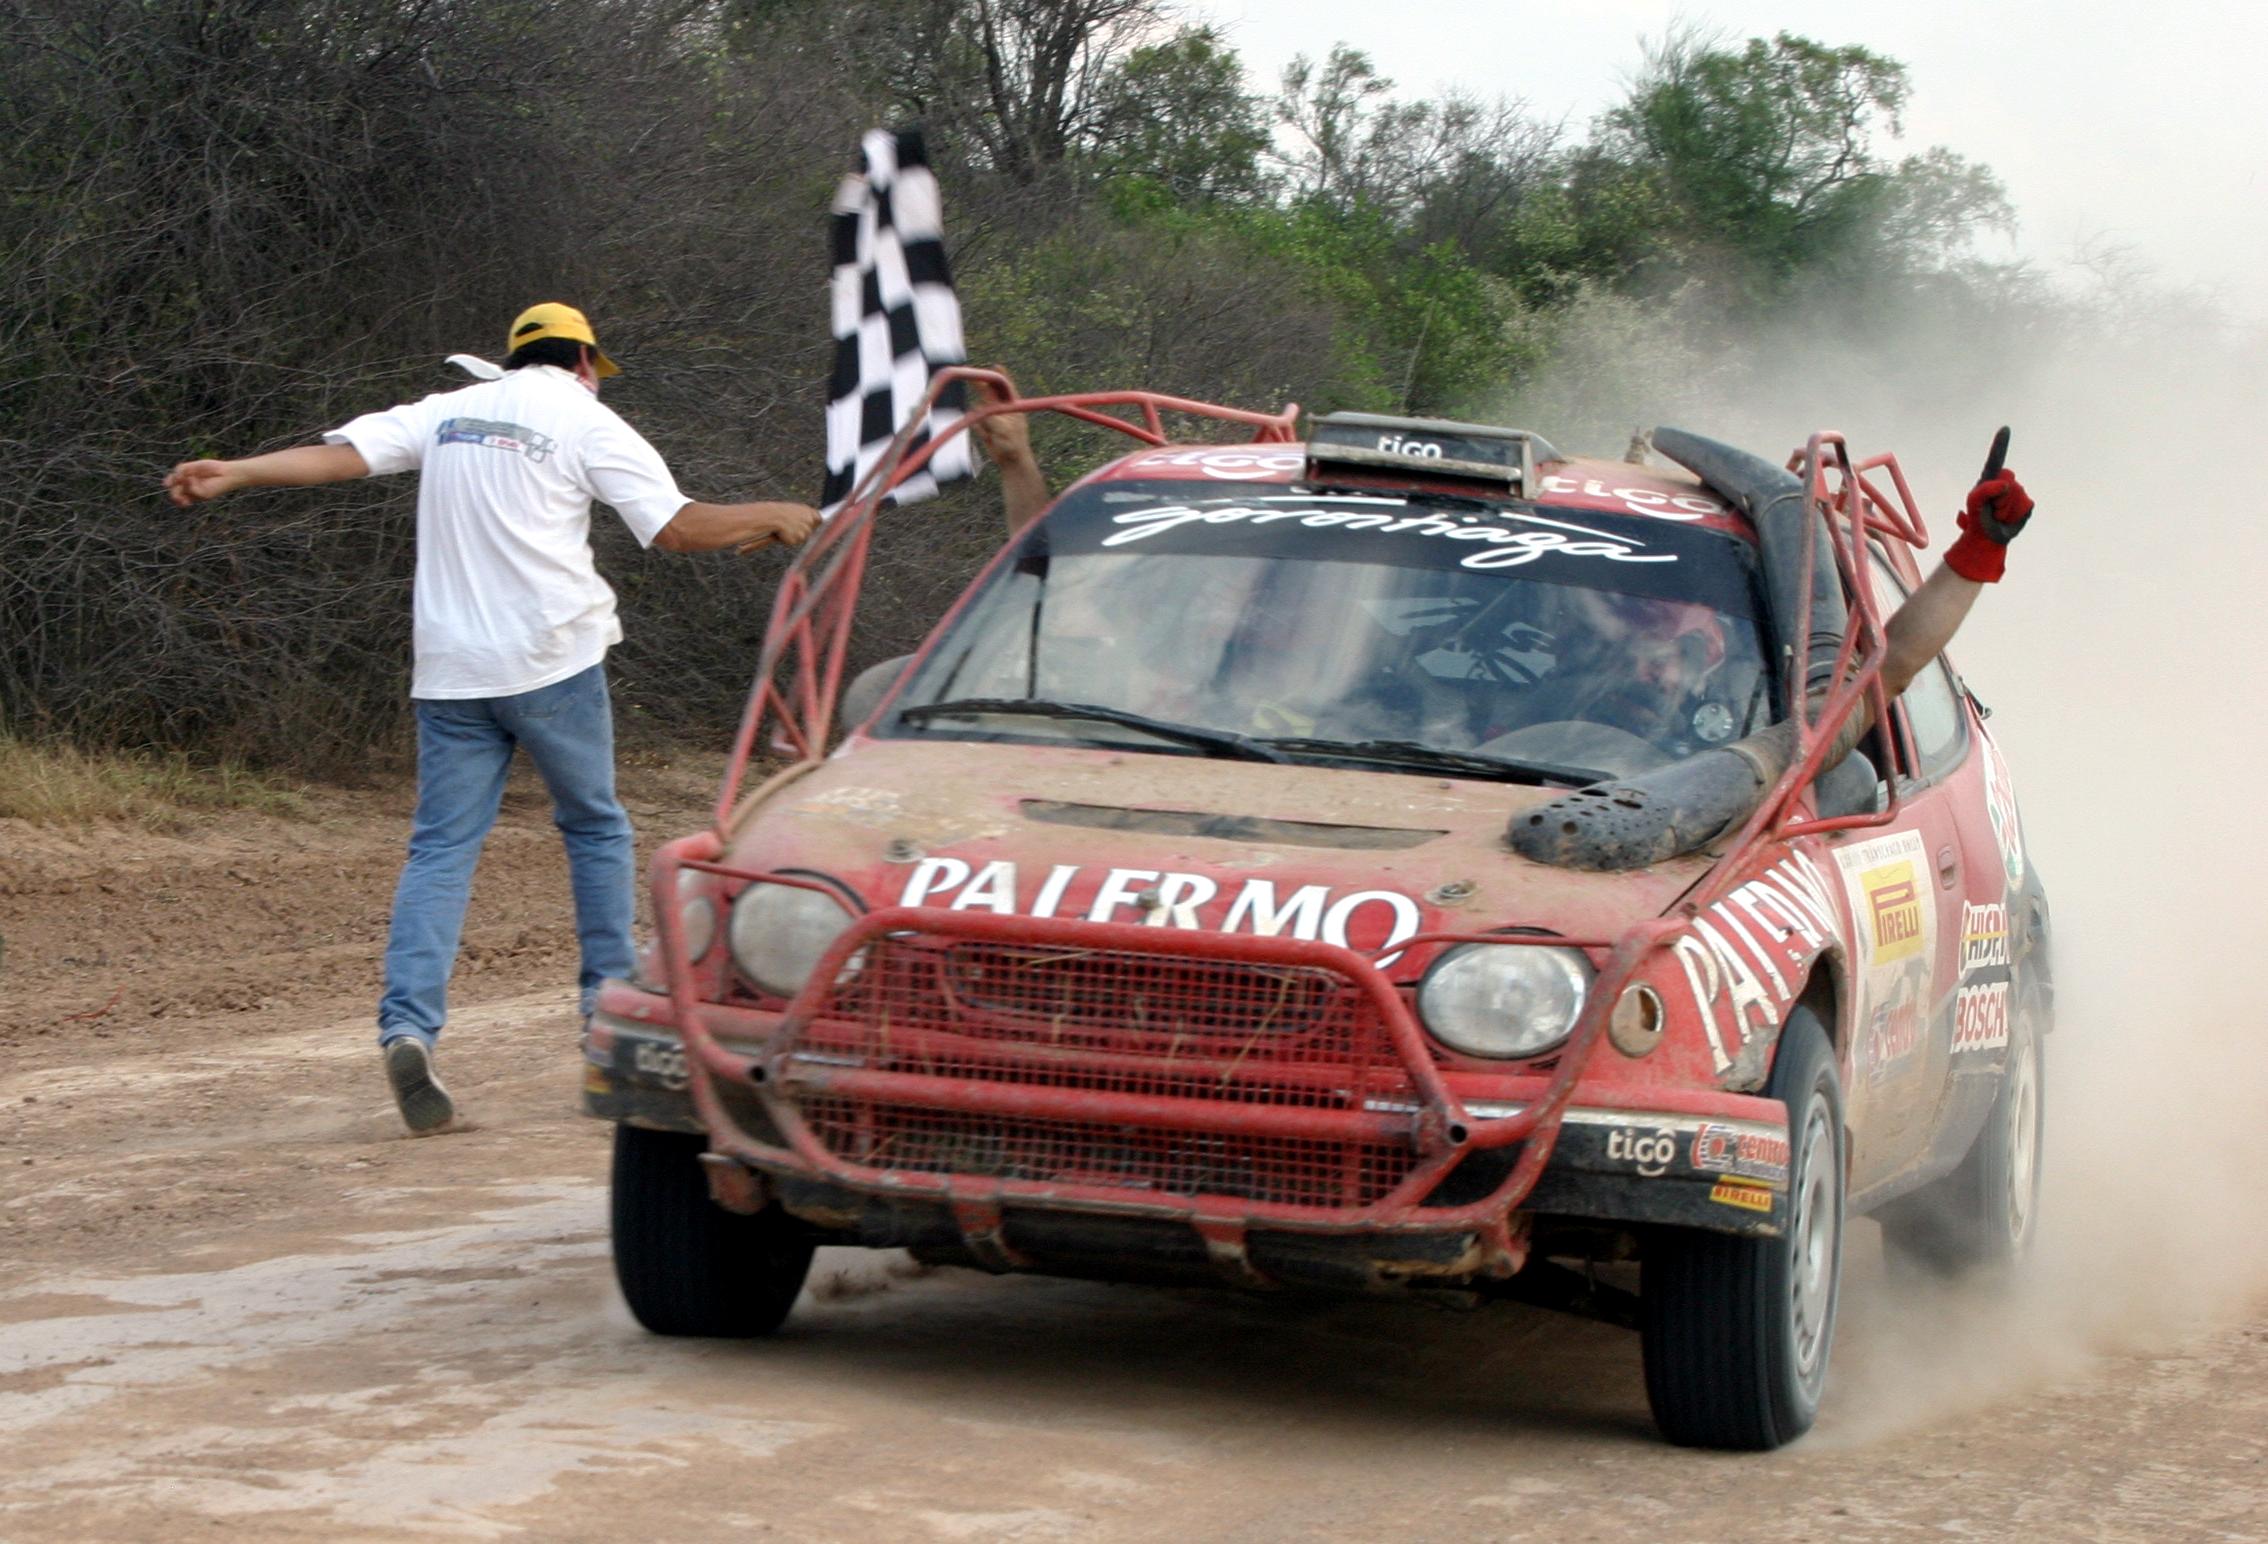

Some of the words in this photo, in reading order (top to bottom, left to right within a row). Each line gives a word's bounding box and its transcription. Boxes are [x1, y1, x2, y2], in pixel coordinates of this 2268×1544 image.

[1136, 453, 1305, 480] tigo
[1378, 435, 1442, 459] tigo
[1541, 476, 1736, 521] tigo
[888, 857, 1421, 969] PALERMO
[1870, 880, 1919, 947] PIRELLI
[1953, 985, 2006, 1048] BOSCH
[1606, 1127, 1676, 1177] tigo
[1712, 1181, 1772, 1208] PIRELLI
